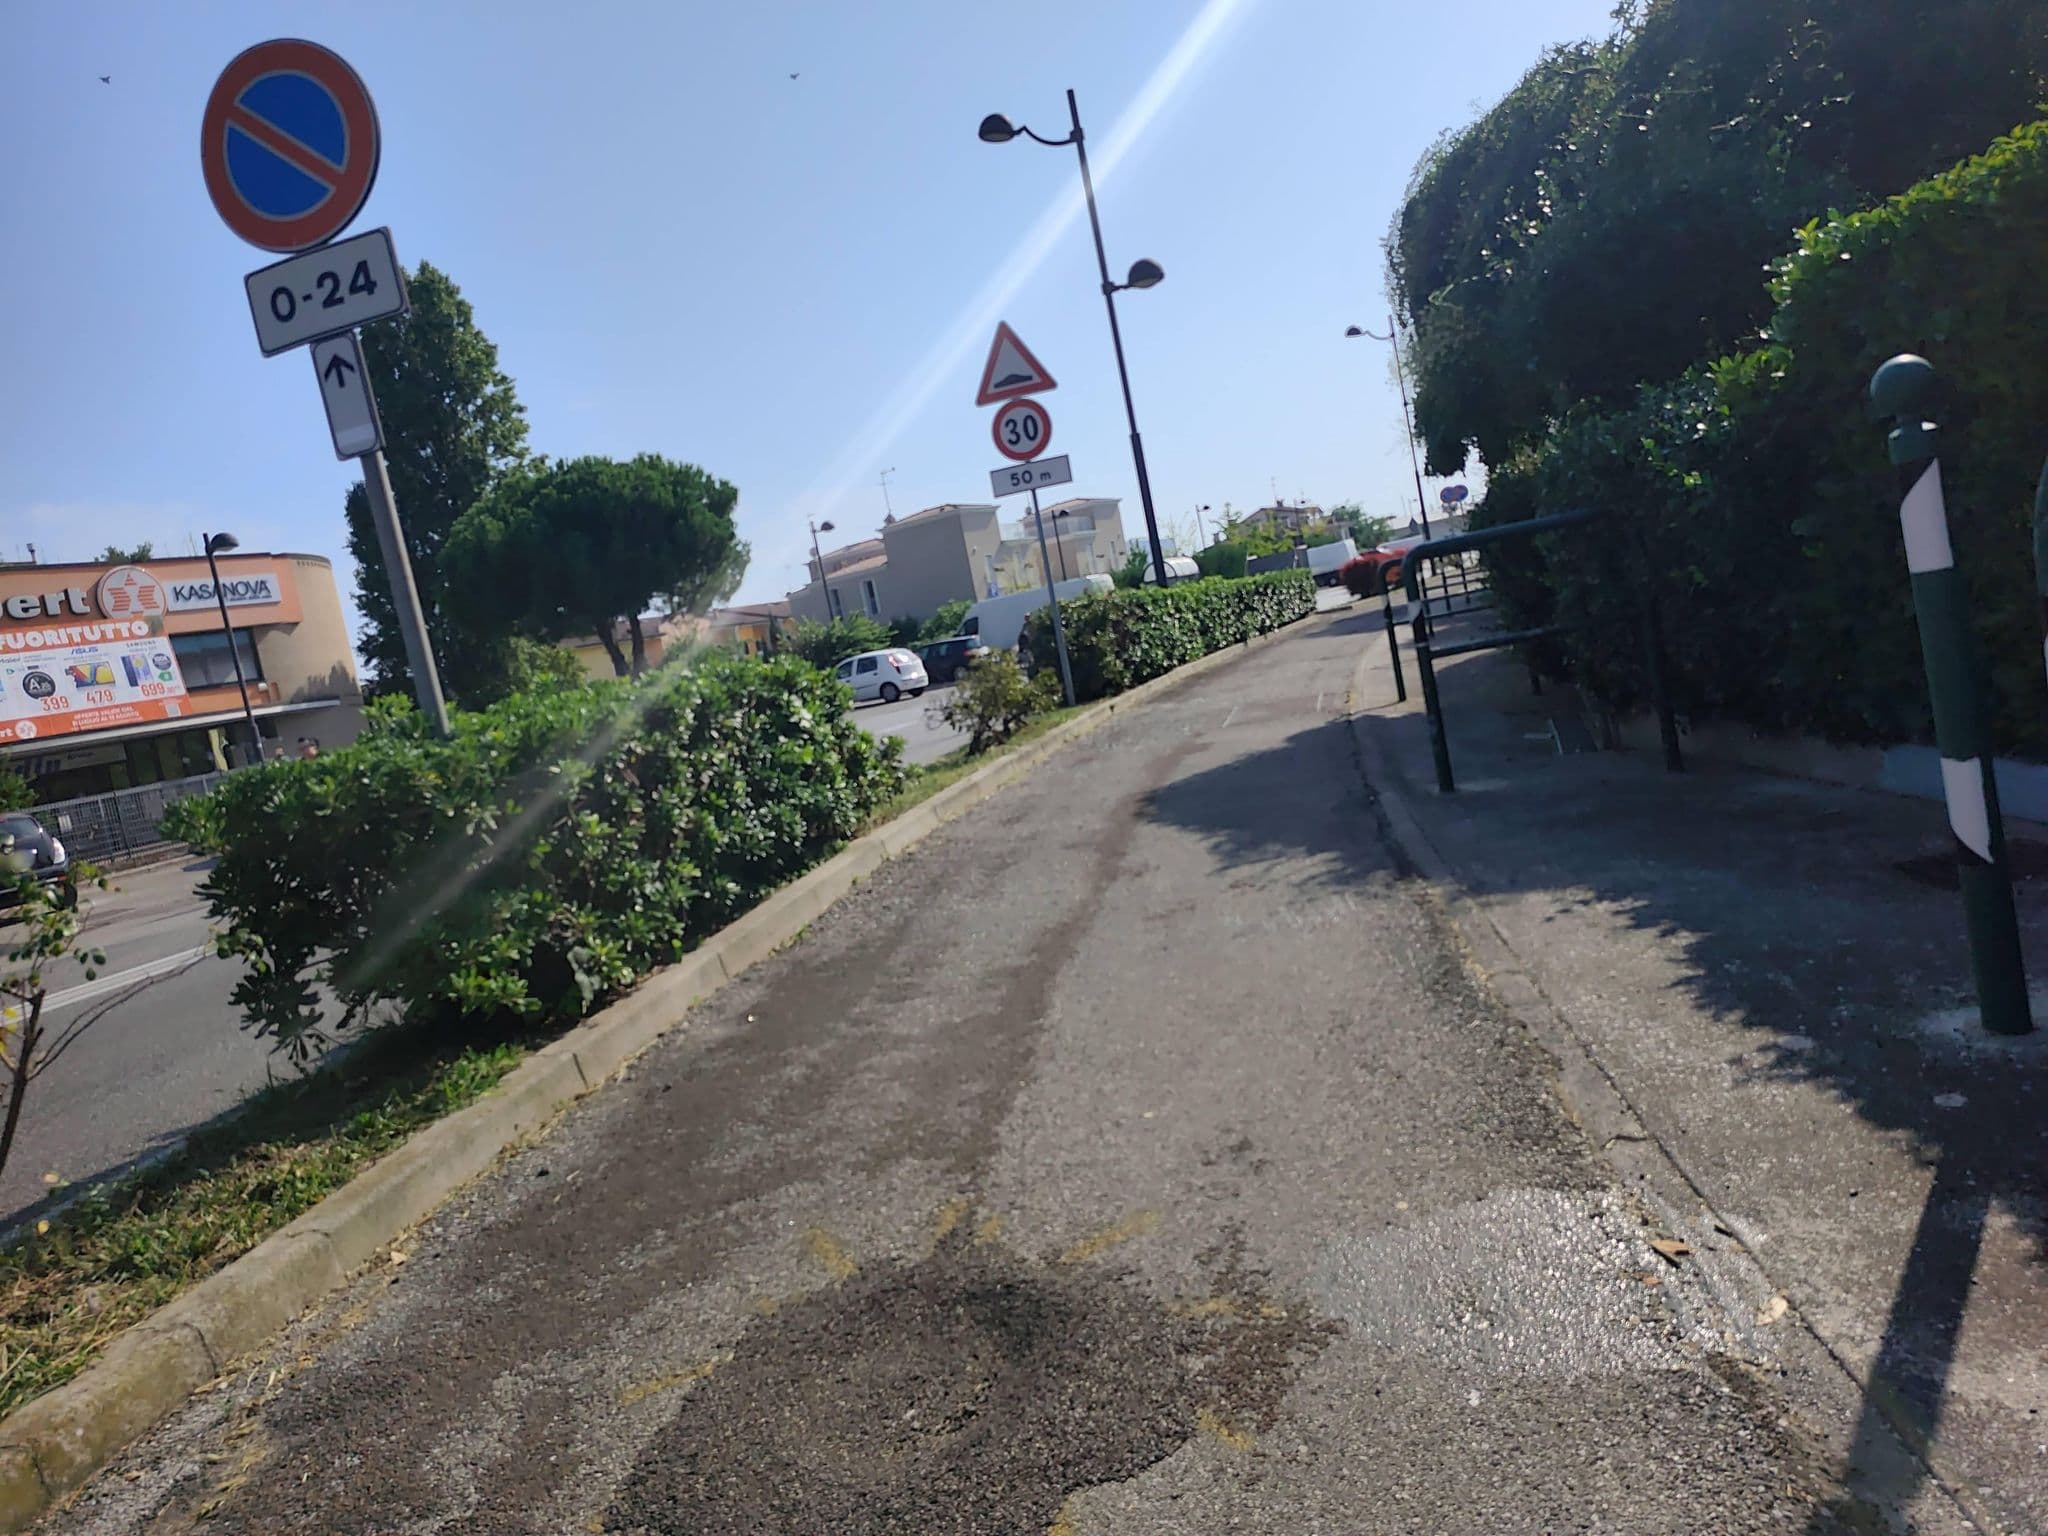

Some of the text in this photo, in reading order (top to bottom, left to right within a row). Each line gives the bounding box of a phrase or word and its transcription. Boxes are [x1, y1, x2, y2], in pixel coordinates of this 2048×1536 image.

[270, 260, 378, 323] 0-24
[1004, 414, 1039, 446] 30
[1010, 470, 1052, 487] 50 m
[0, 588, 90, 619] ert
[86, 689, 113, 704] 479
[141, 682, 165, 697] 699
[40, 696, 69, 711] 399
